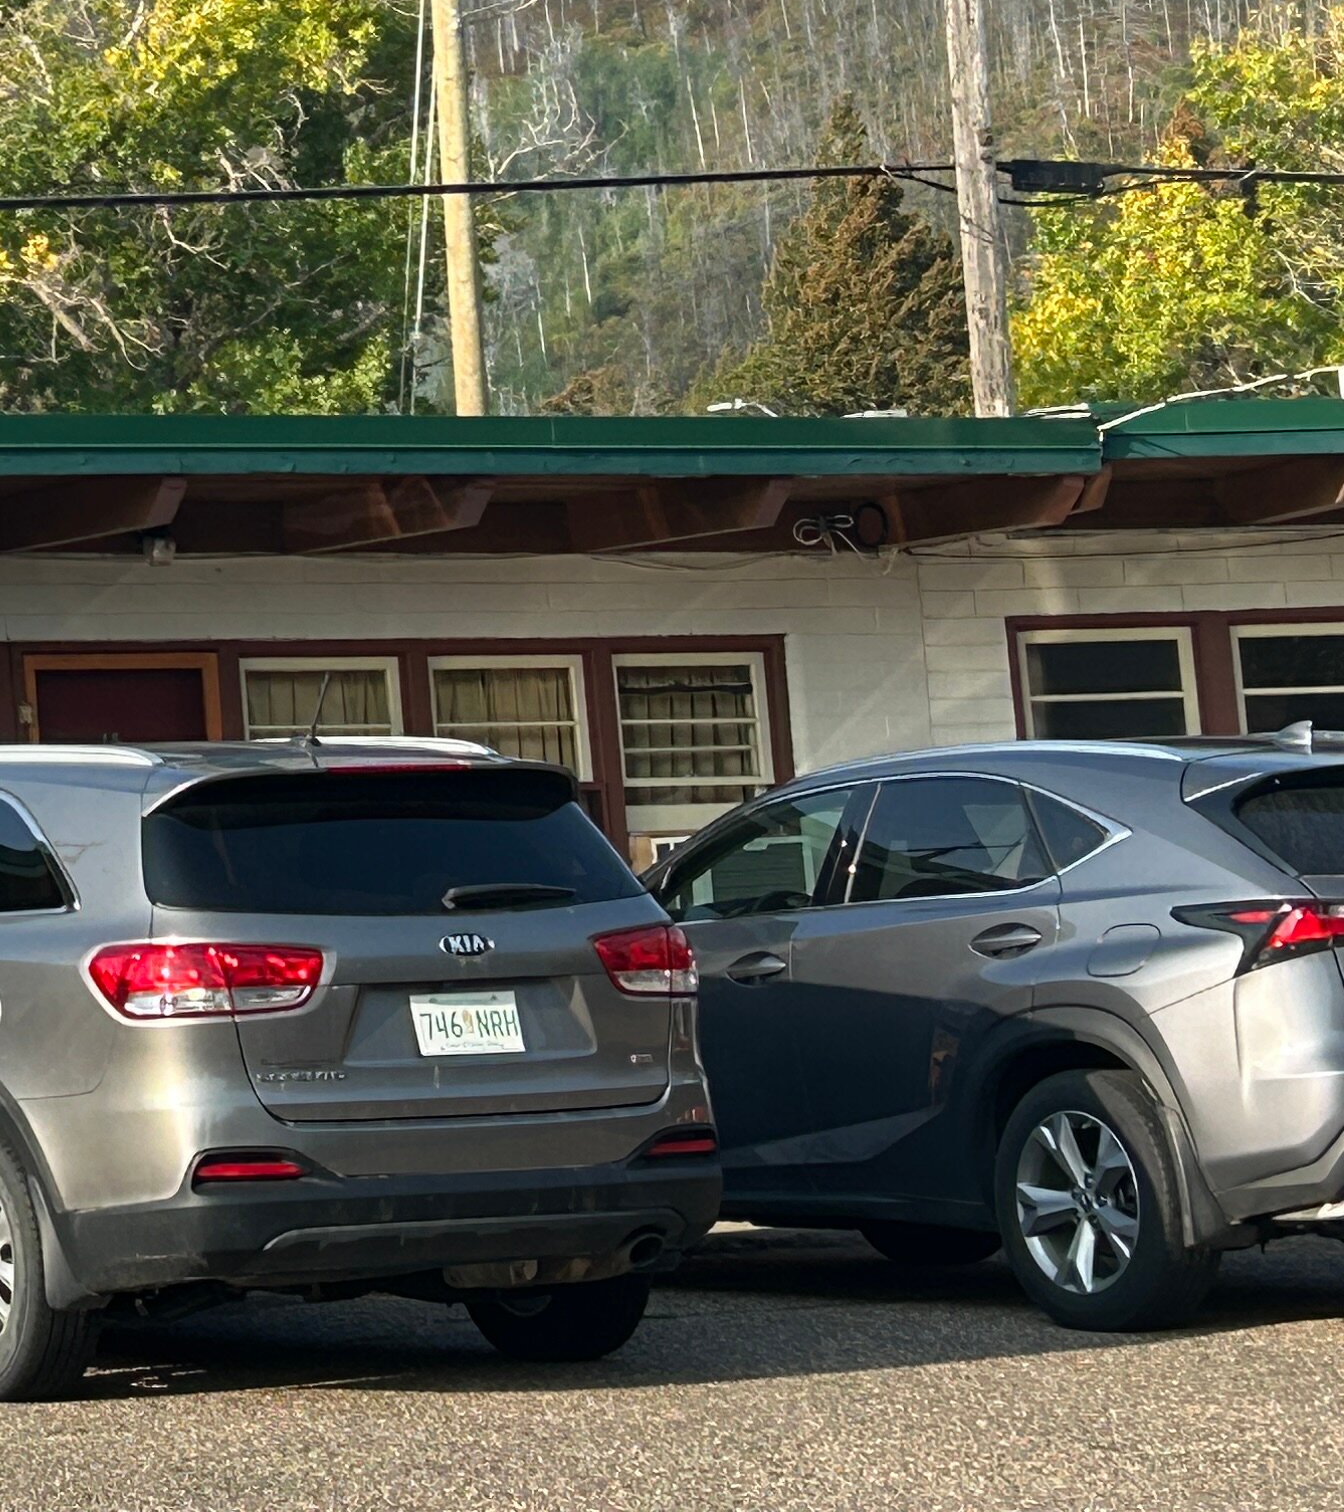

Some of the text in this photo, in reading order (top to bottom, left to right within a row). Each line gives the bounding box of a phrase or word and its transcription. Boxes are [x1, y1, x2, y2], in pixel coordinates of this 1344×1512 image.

[447, 934, 485, 953] KIA
[419, 1009, 519, 1040] 746 NRH
